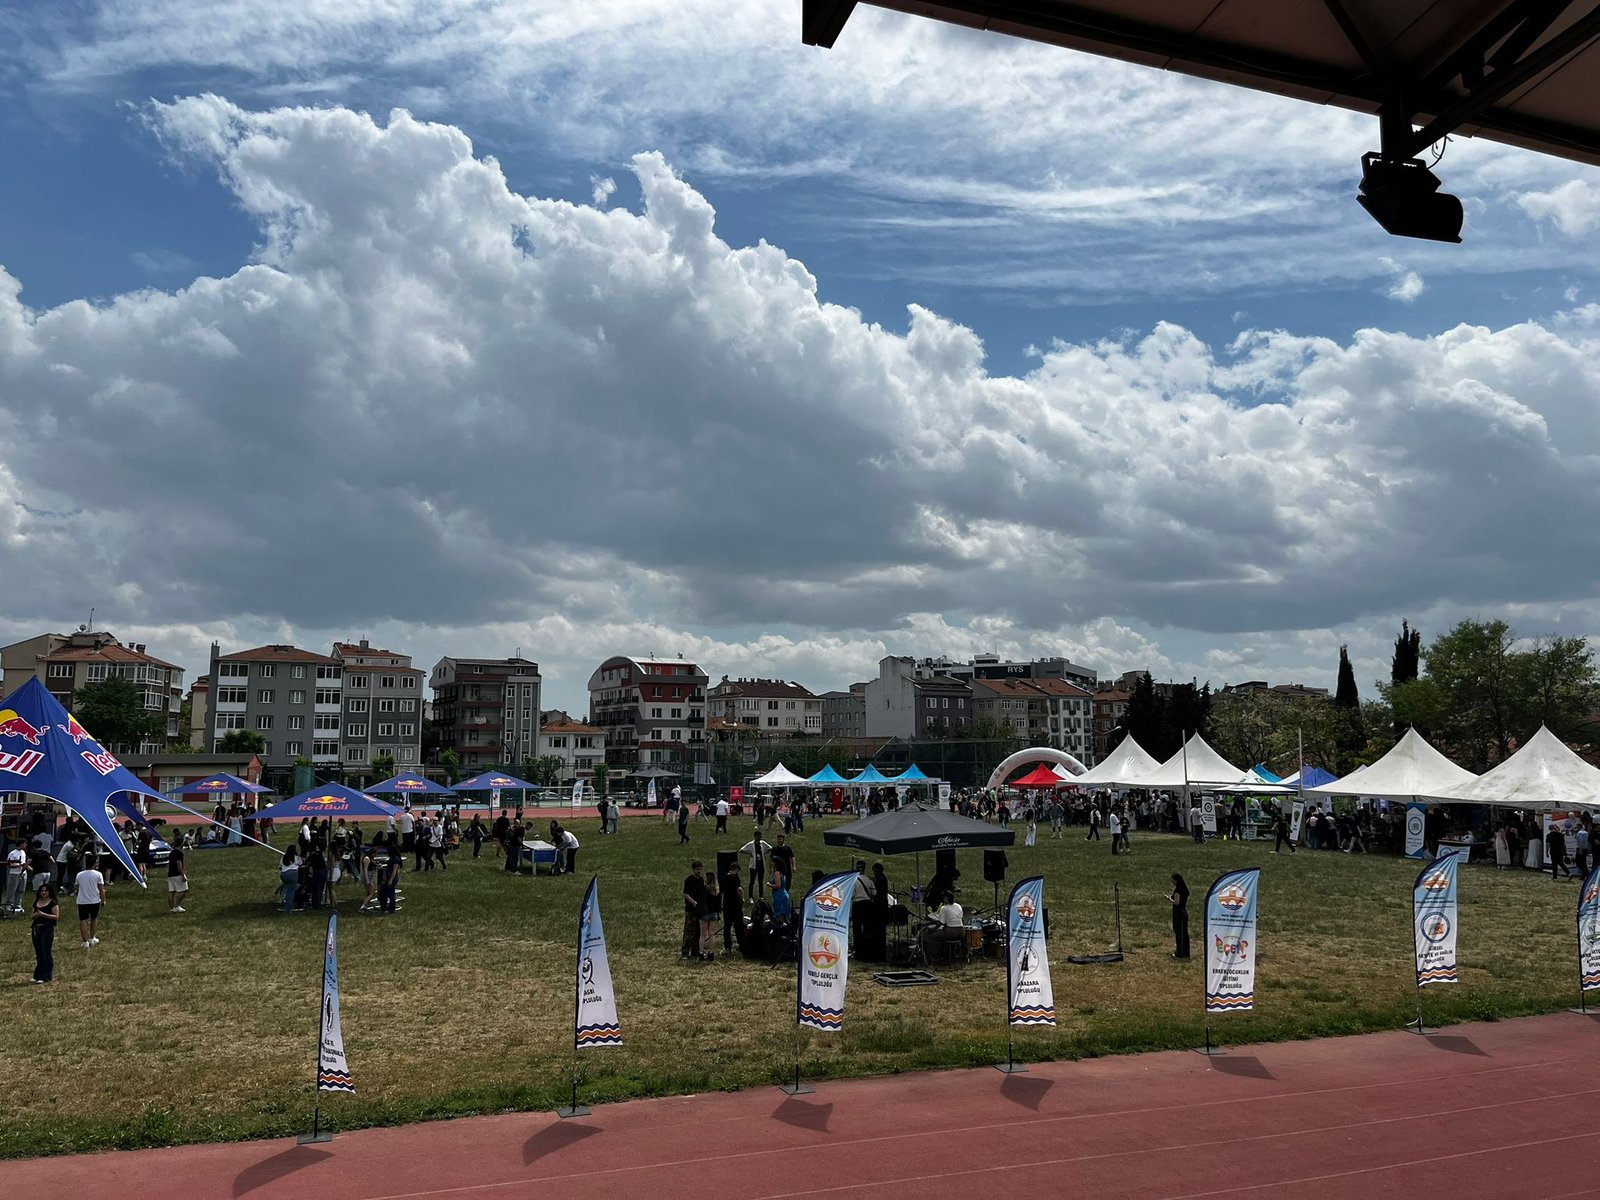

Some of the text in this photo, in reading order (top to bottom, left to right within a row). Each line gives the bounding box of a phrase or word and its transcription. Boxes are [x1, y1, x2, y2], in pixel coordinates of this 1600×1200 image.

[1007, 665, 1024, 673] RYS
[0, 749, 45, 776] ull
[324, 803, 349, 811] Bull
